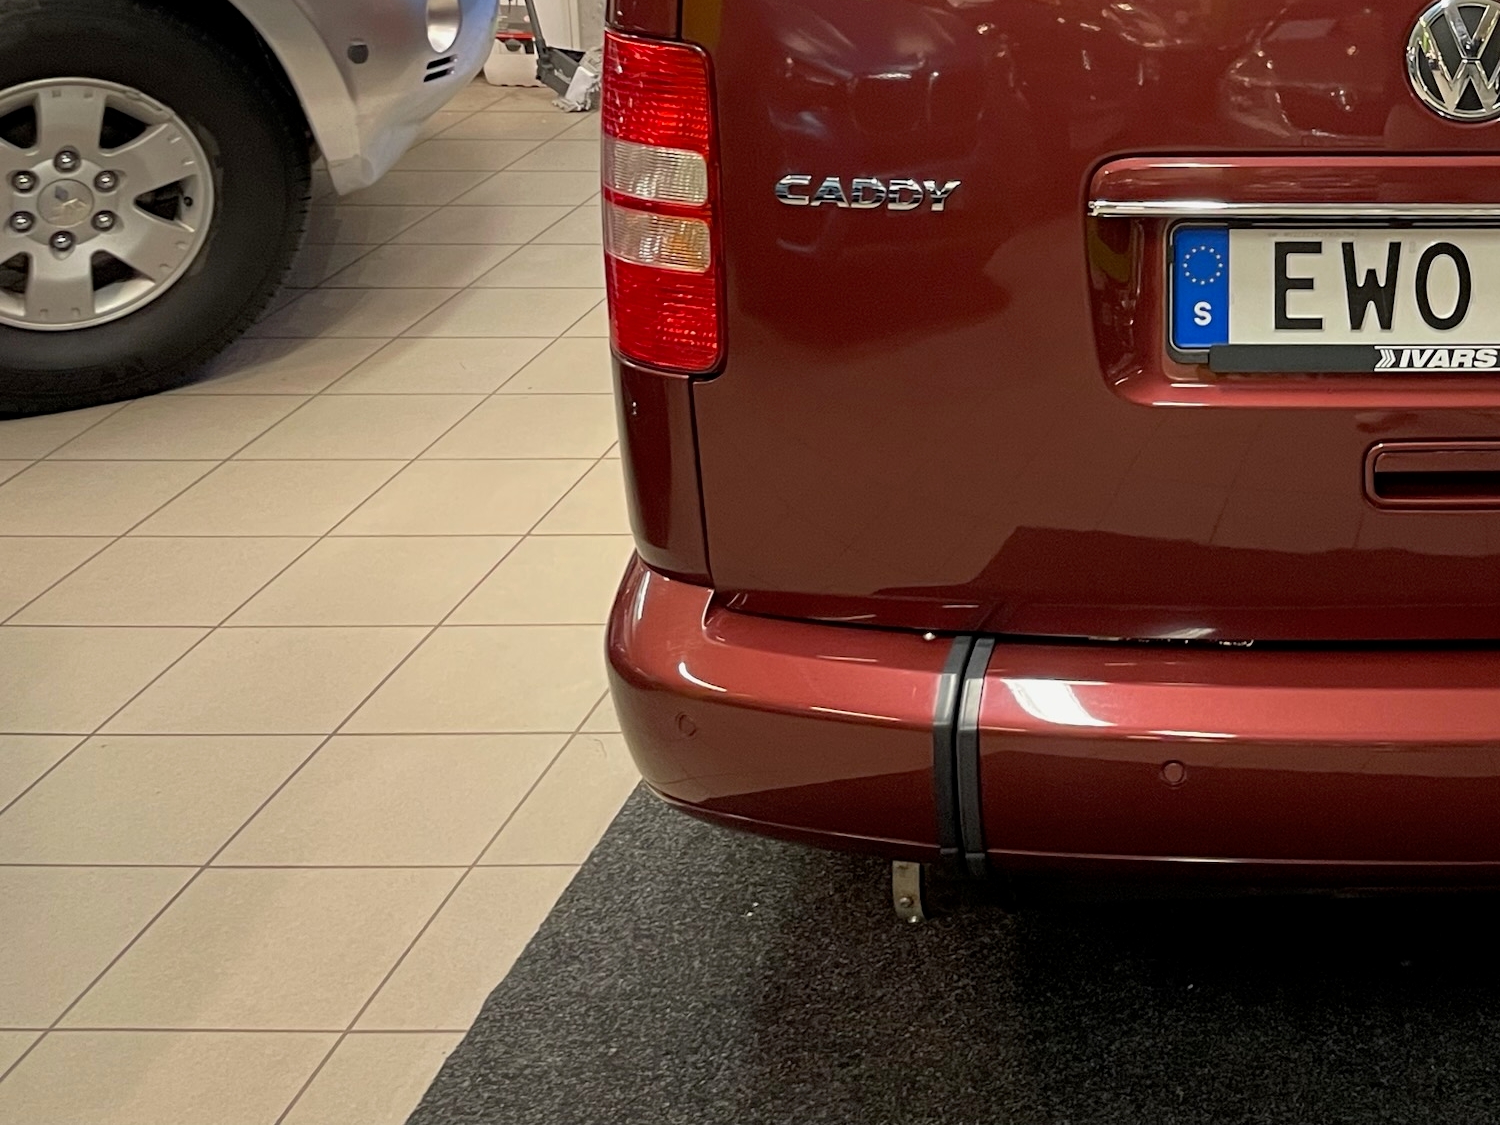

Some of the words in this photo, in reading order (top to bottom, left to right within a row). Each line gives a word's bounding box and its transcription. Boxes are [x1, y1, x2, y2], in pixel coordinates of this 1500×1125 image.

[774, 174, 961, 212] CADDY
[1193, 300, 1212, 326] S
[1273, 240, 1472, 331] EWO
[1399, 348, 1498, 368] IVARS
